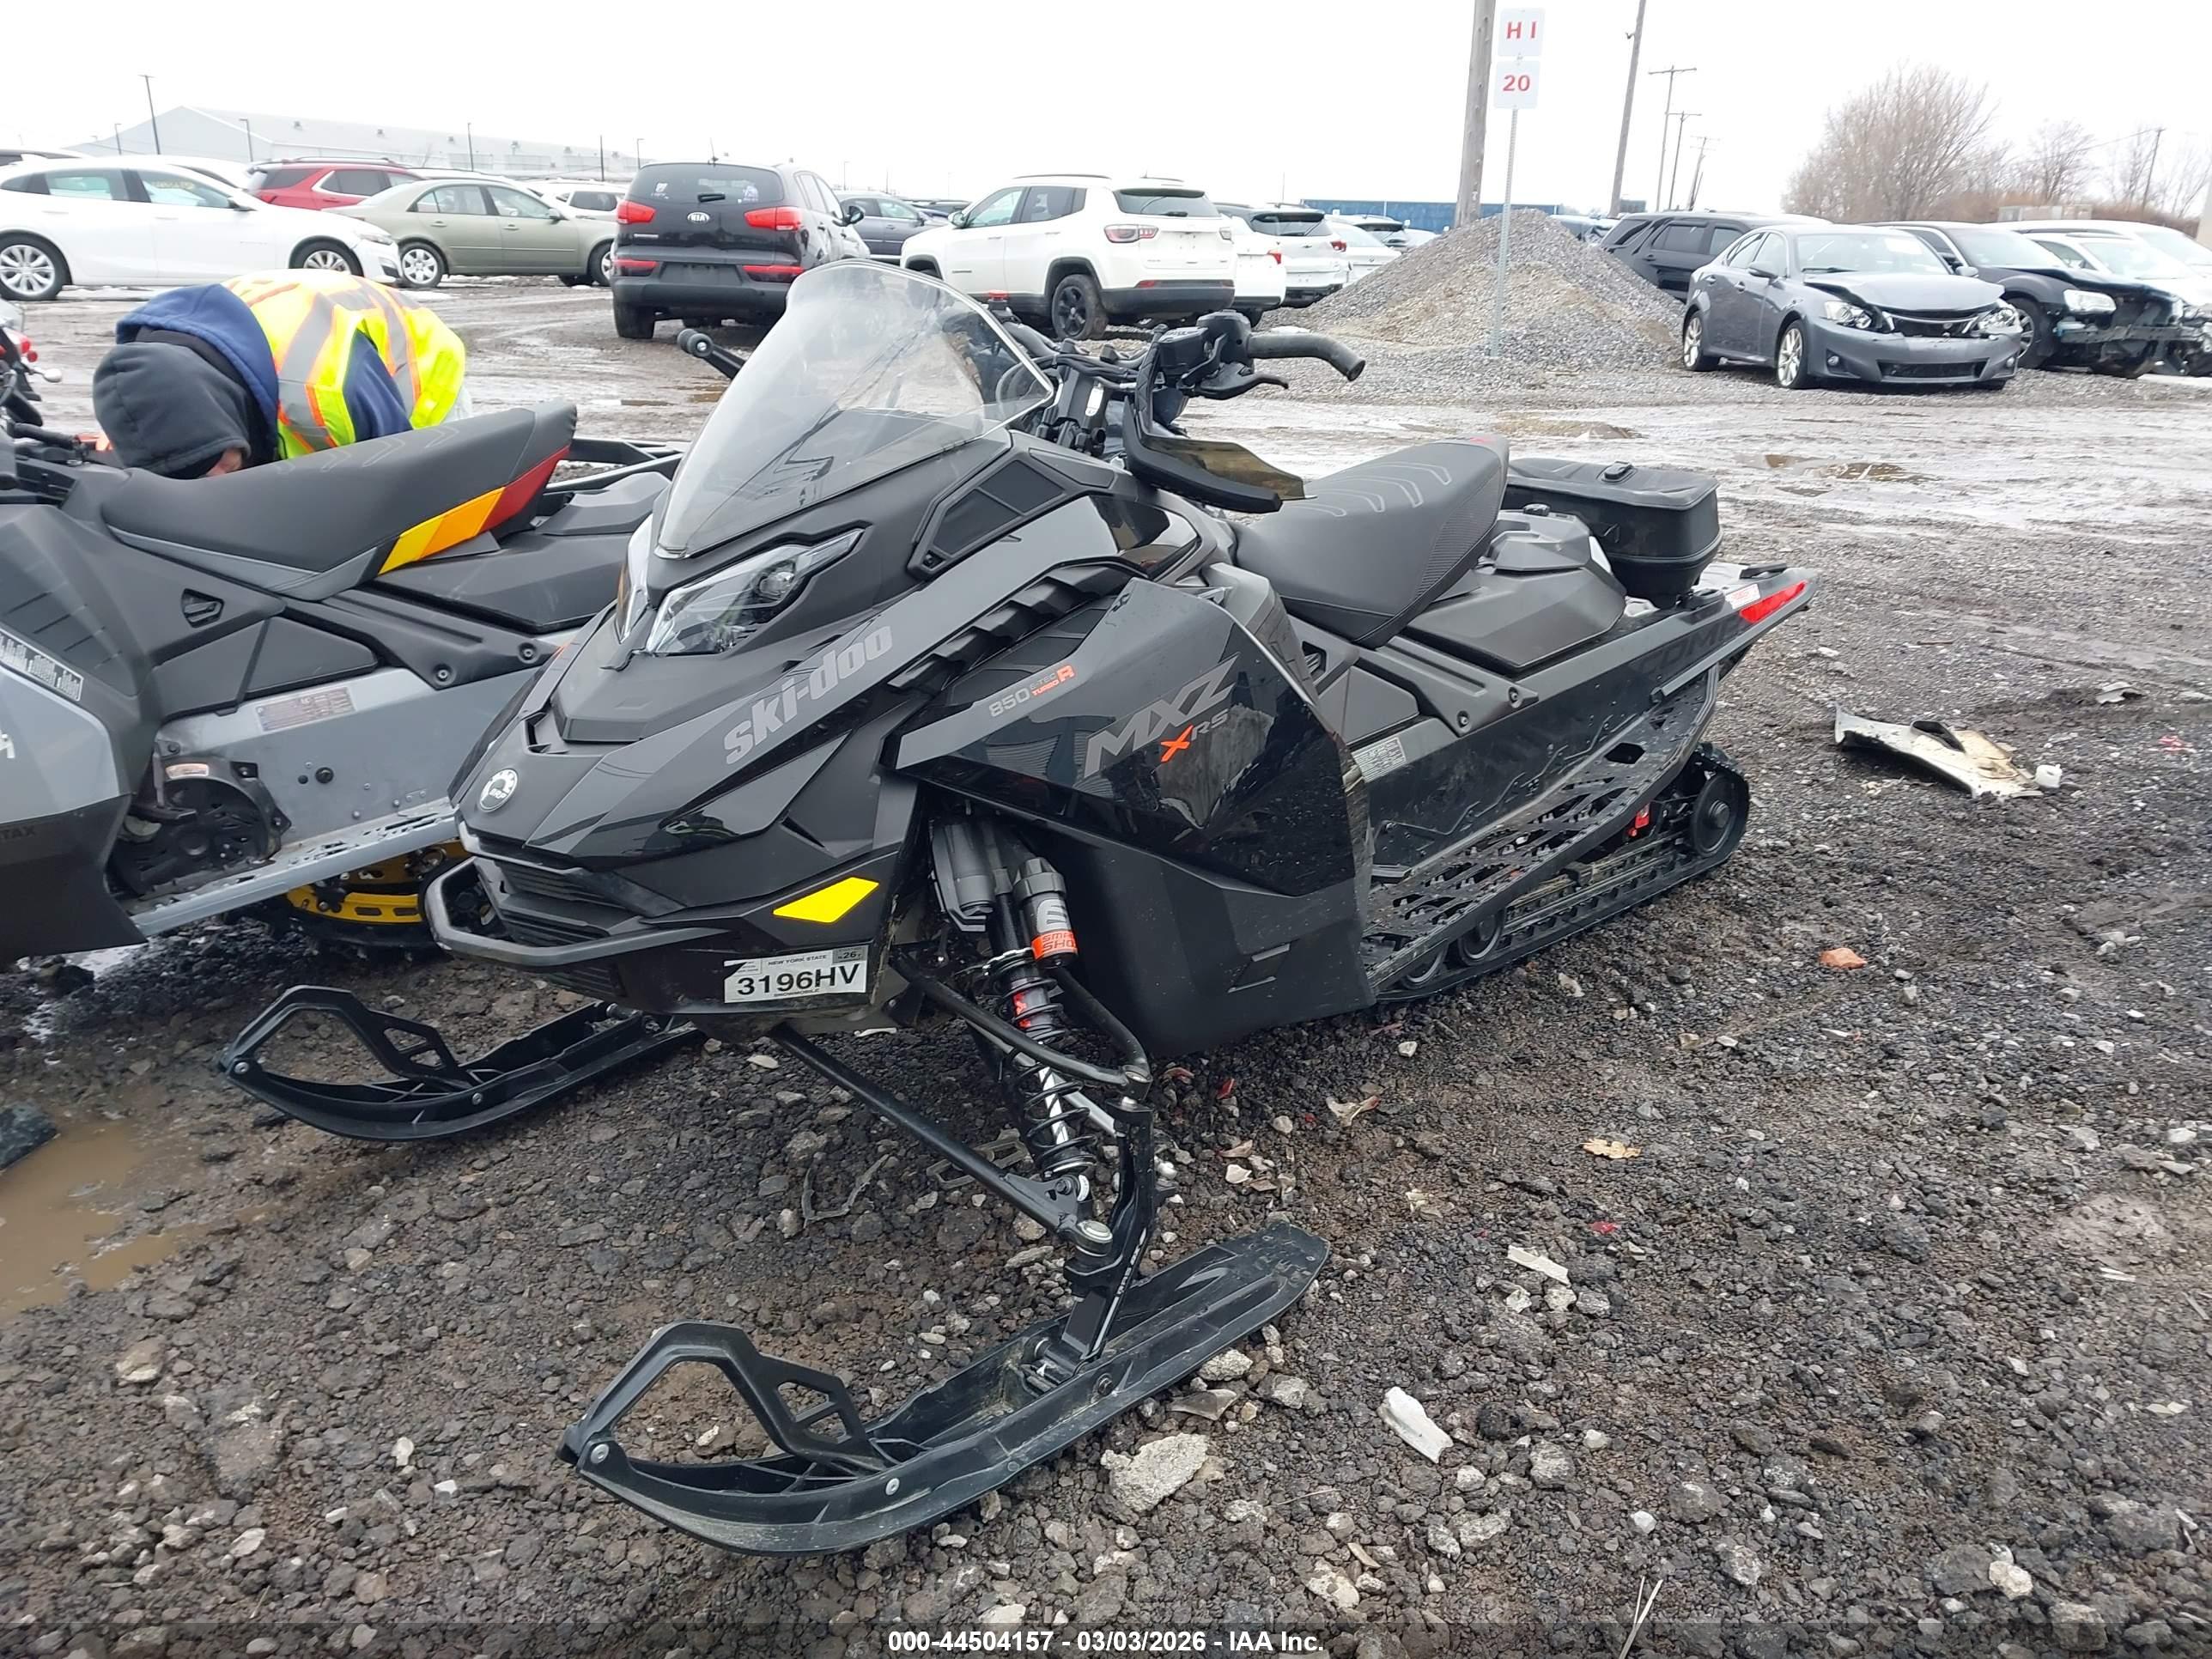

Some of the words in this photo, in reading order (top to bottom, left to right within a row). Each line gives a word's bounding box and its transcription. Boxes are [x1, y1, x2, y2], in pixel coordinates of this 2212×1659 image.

[1503, 75, 1530, 91] 20
[1031, 678, 1060, 696] TURBO
[1057, 665, 1075, 683] R
[988, 687, 1030, 717] 850
[1084, 651, 1239, 779] MXZ
[737, 963, 860, 996] 3196HV
